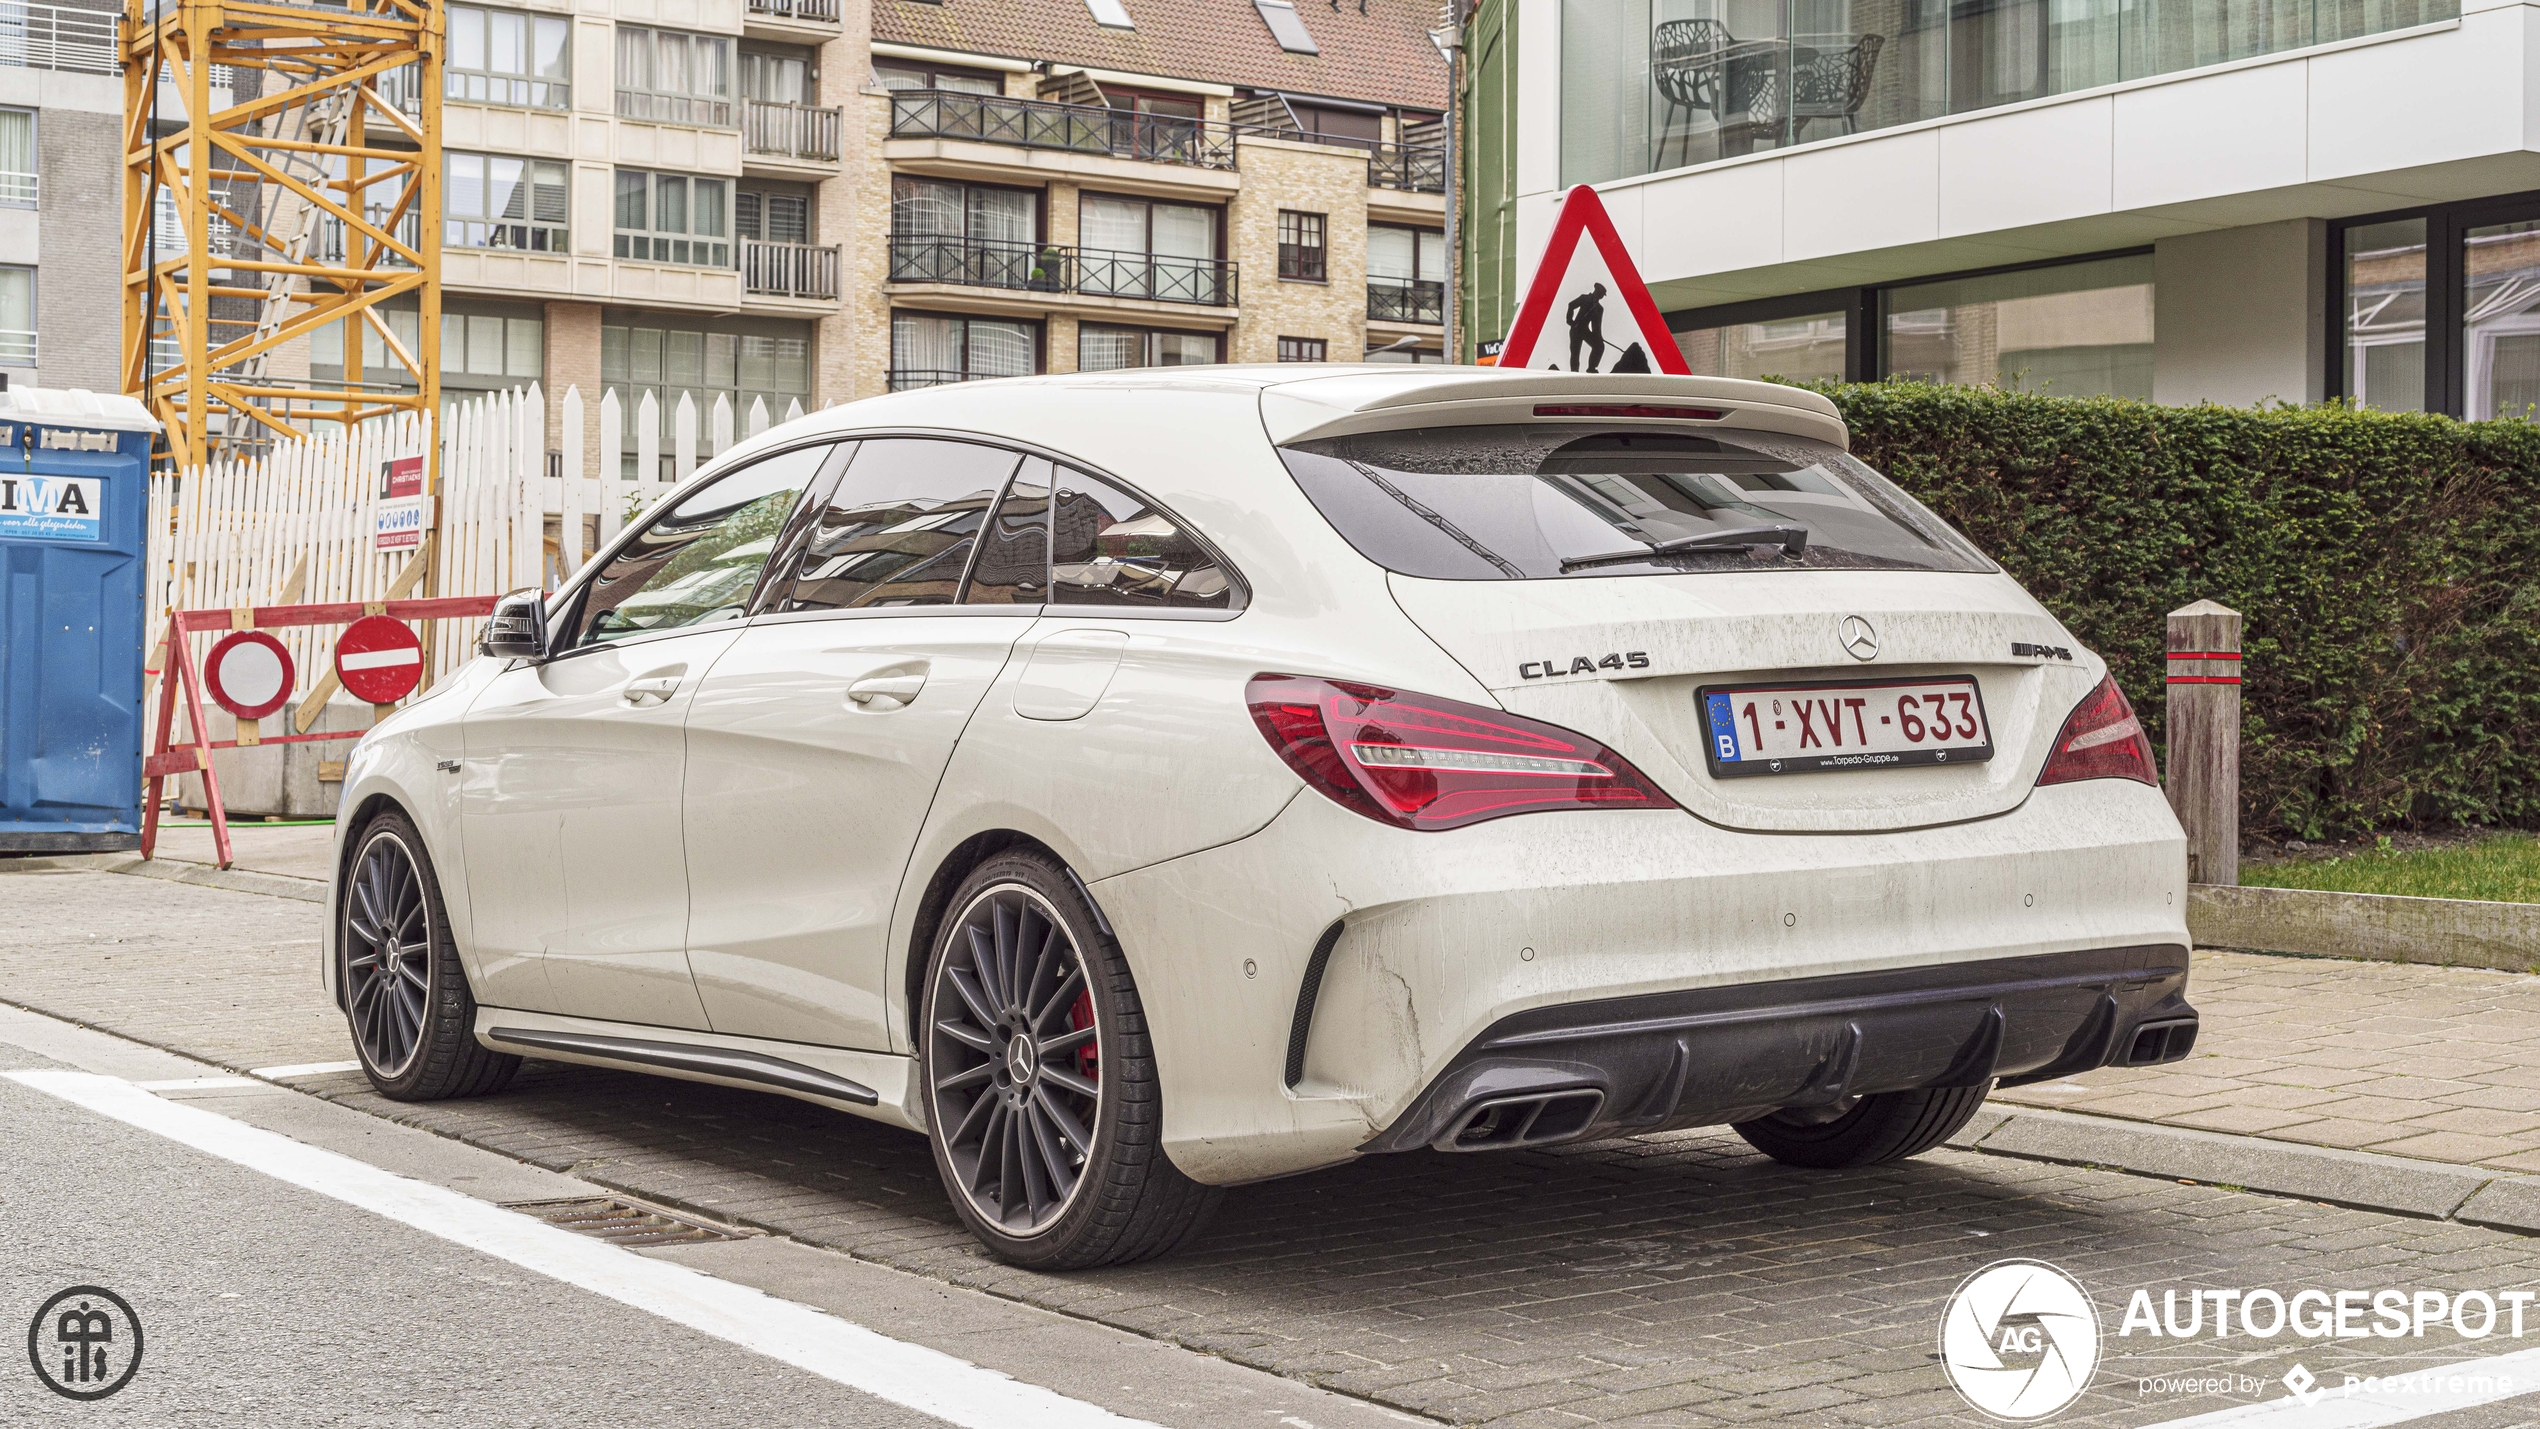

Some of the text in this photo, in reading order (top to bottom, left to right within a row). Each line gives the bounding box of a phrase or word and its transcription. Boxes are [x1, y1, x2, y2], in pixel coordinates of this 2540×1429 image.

[0, 480, 89, 514] IMA
[22, 517, 39, 527] alle
[1718, 734, 1736, 758] B
[1820, 754, 1899, 766] www.Torpedo-Gruppe.de
